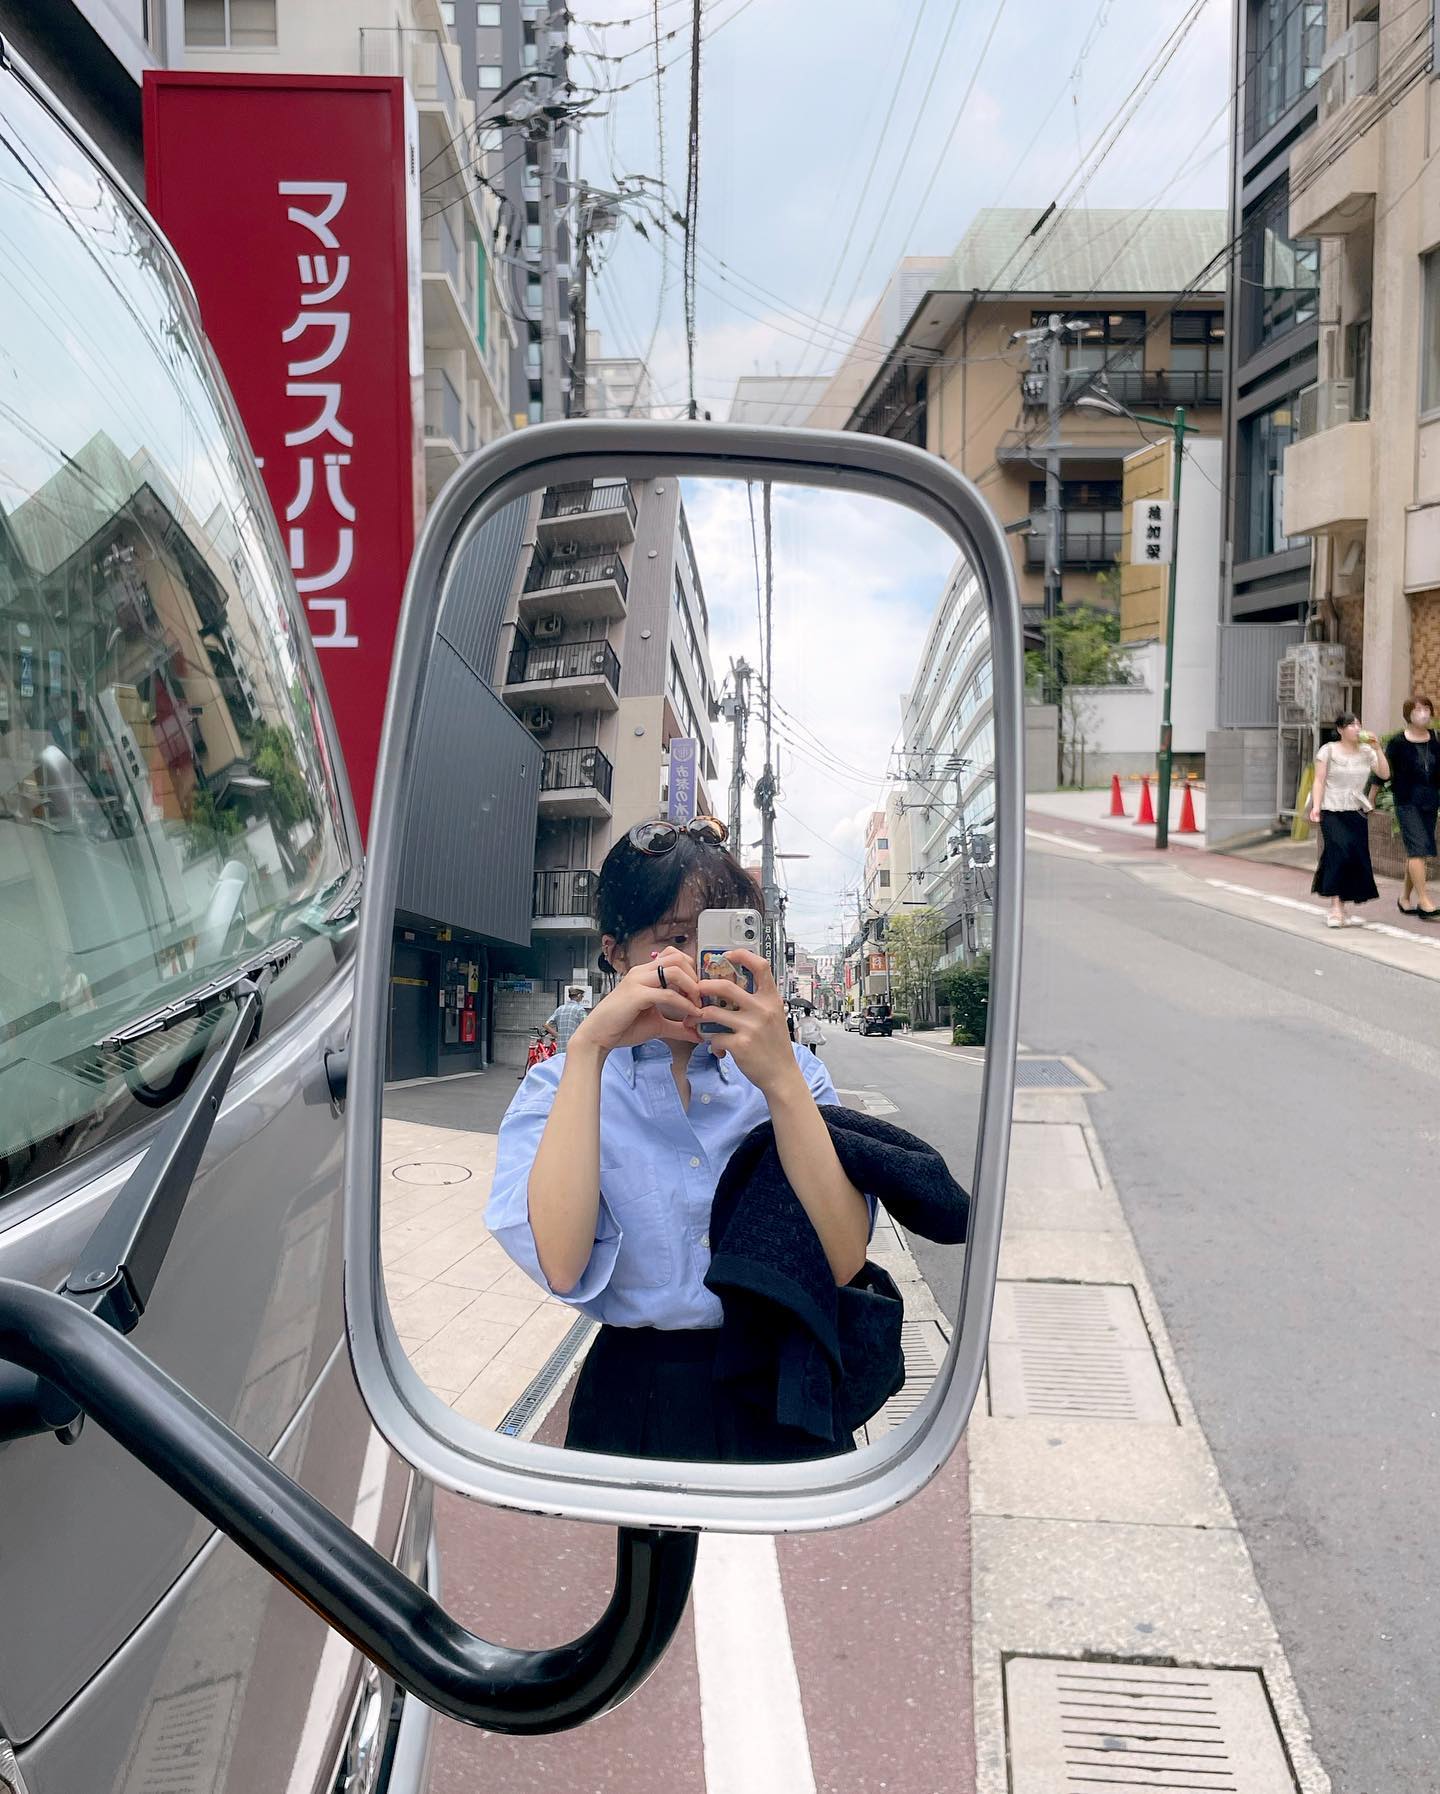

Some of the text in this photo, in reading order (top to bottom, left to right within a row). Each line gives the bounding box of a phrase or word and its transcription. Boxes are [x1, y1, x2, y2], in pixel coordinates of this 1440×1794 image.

[278, 180, 359, 649] マックスバリュ
